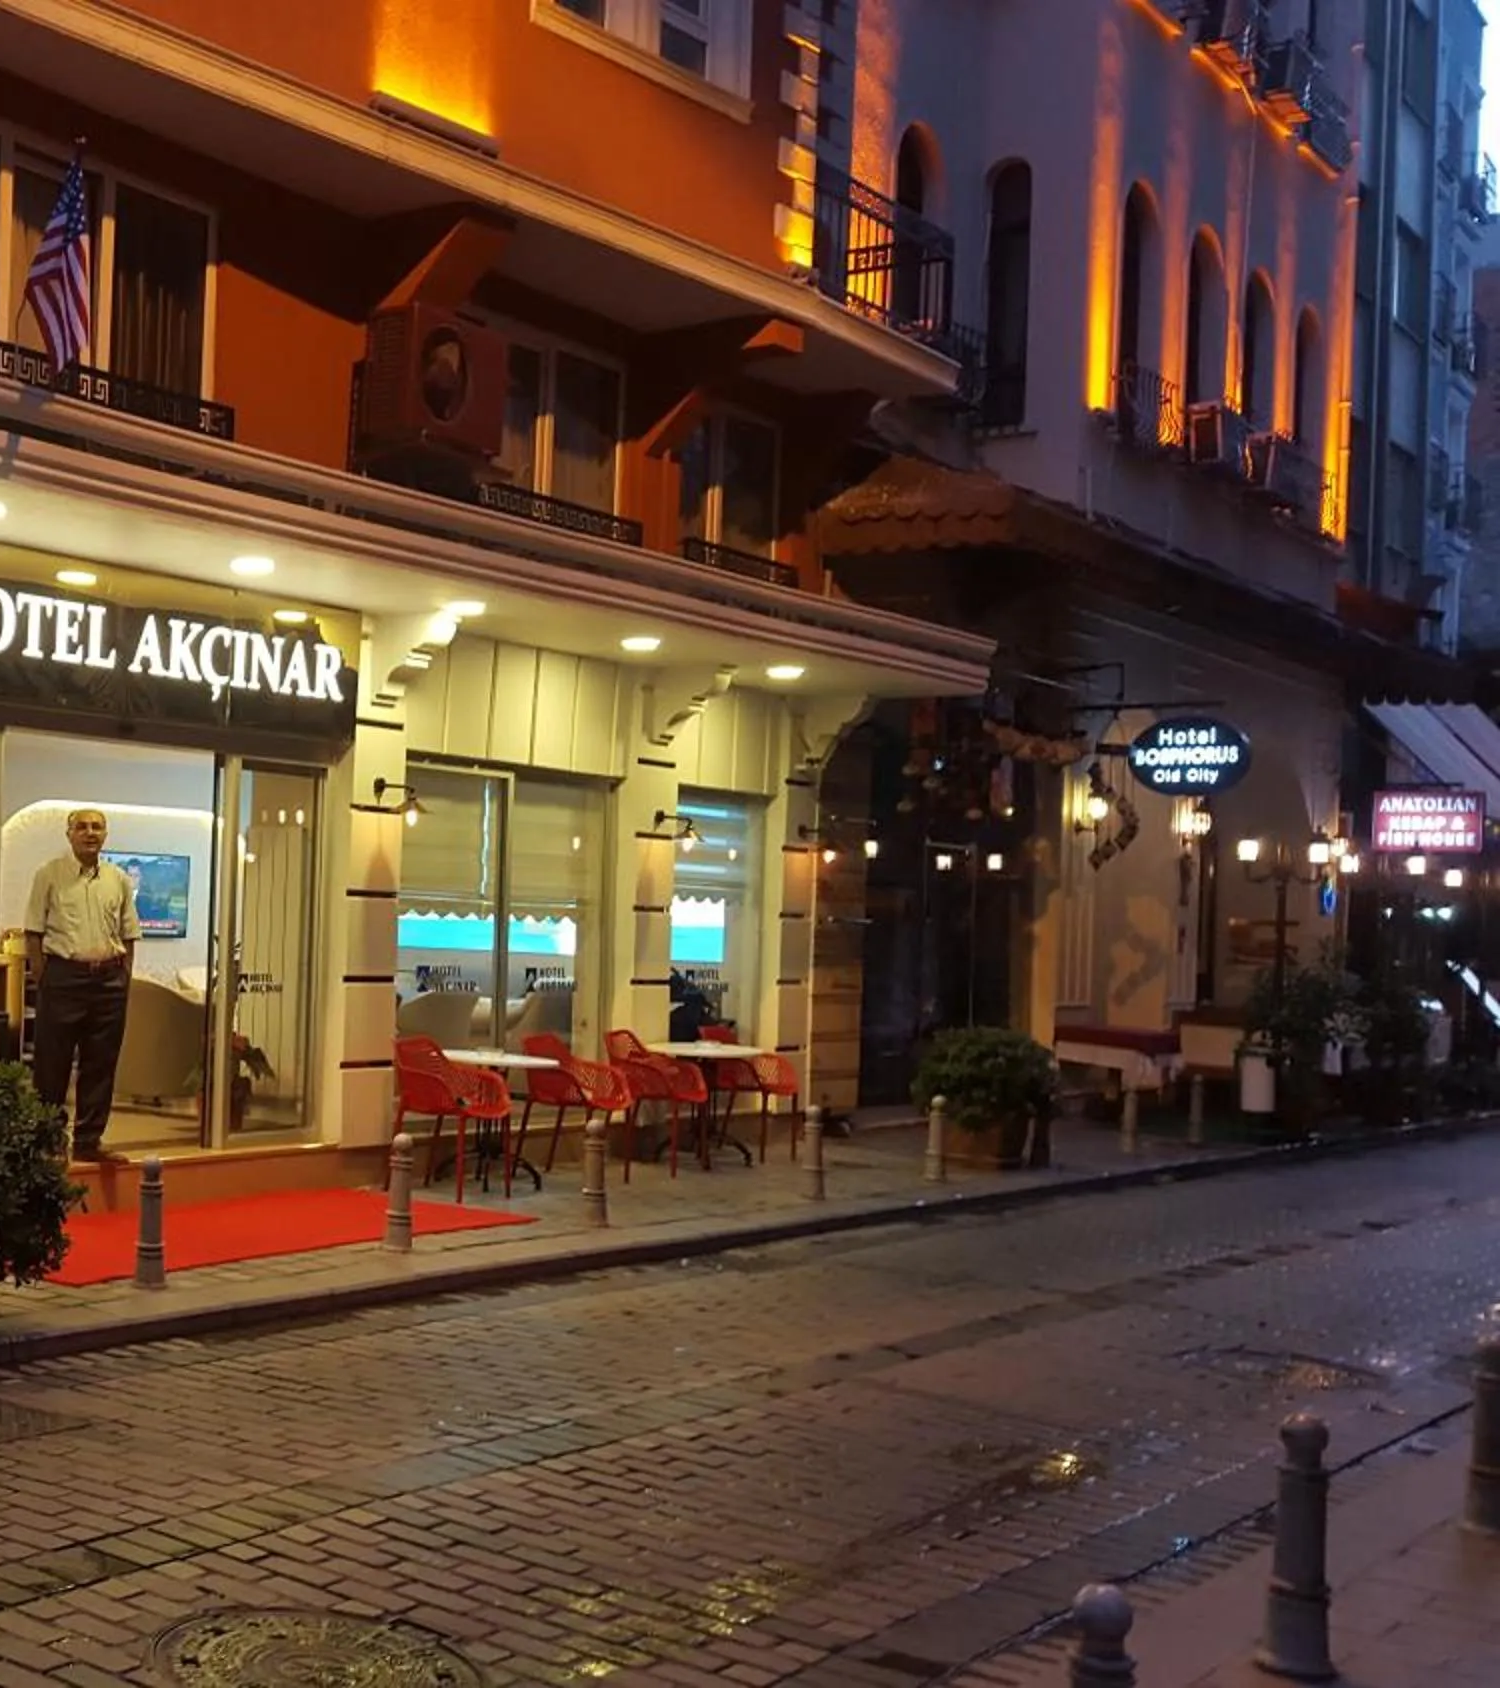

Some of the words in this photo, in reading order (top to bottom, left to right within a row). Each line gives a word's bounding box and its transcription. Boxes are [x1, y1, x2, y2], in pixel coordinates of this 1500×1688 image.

[128, 614, 345, 702] AKÇINAR
[1158, 726, 1217, 746] Hotel
[1135, 745, 1239, 766] BOSPHORUS
[1153, 769, 1181, 783] Old
[1186, 768, 1219, 784] City
[1379, 796, 1477, 813] ANATOLIAN
